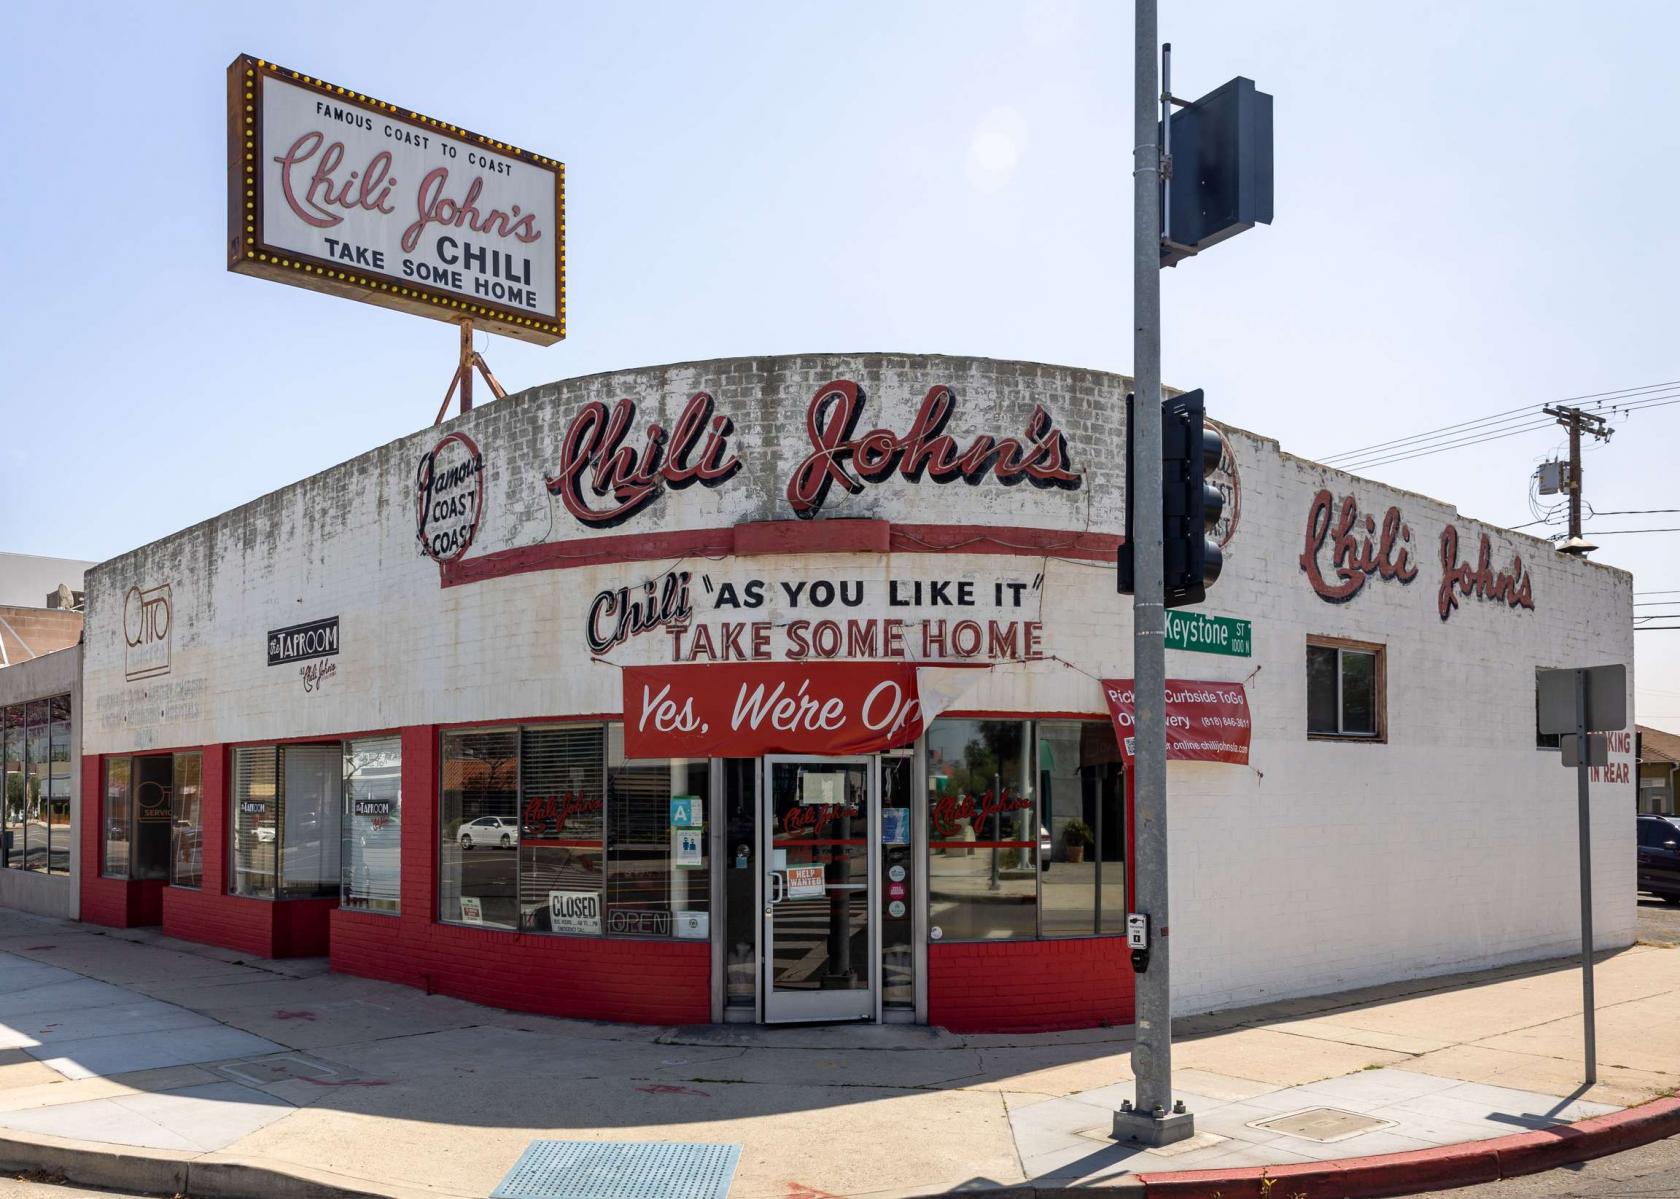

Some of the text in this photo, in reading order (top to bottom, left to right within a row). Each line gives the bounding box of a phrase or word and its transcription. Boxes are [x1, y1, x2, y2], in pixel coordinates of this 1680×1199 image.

[317, 102, 512, 176] FAMOUS COAST TO COAST
[274, 131, 541, 253] Chili John's
[324, 237, 537, 308] TAKE SOME HOME
[436, 236, 531, 285] CHILI
[544, 379, 1082, 529] Chili John's
[433, 490, 475, 522] COAST
[432, 523, 475, 556] COAST
[1299, 488, 1535, 622] Chili John's
[586, 571, 692, 655] Chili
[780, 580, 864, 608] YOU
[889, 579, 975, 607] LIKE
[1164, 611, 1245, 647] Keystone ST
[278, 626, 337, 658] TAPROOM
[665, 619, 1043, 662] TAKE SOME HOME
[638, 683, 709, 734] Yes,
[730, 678, 847, 732] We're
[1164, 689, 1217, 703] Curbside
[1216, 692, 1244, 705] ToGo
[1201, 717, 1223, 728] (818)
[1604, 763, 1629, 783] REAR
[674, 805, 688, 821] A
[553, 896, 597, 919] CLOSED
[612, 911, 666, 934] OPEN
